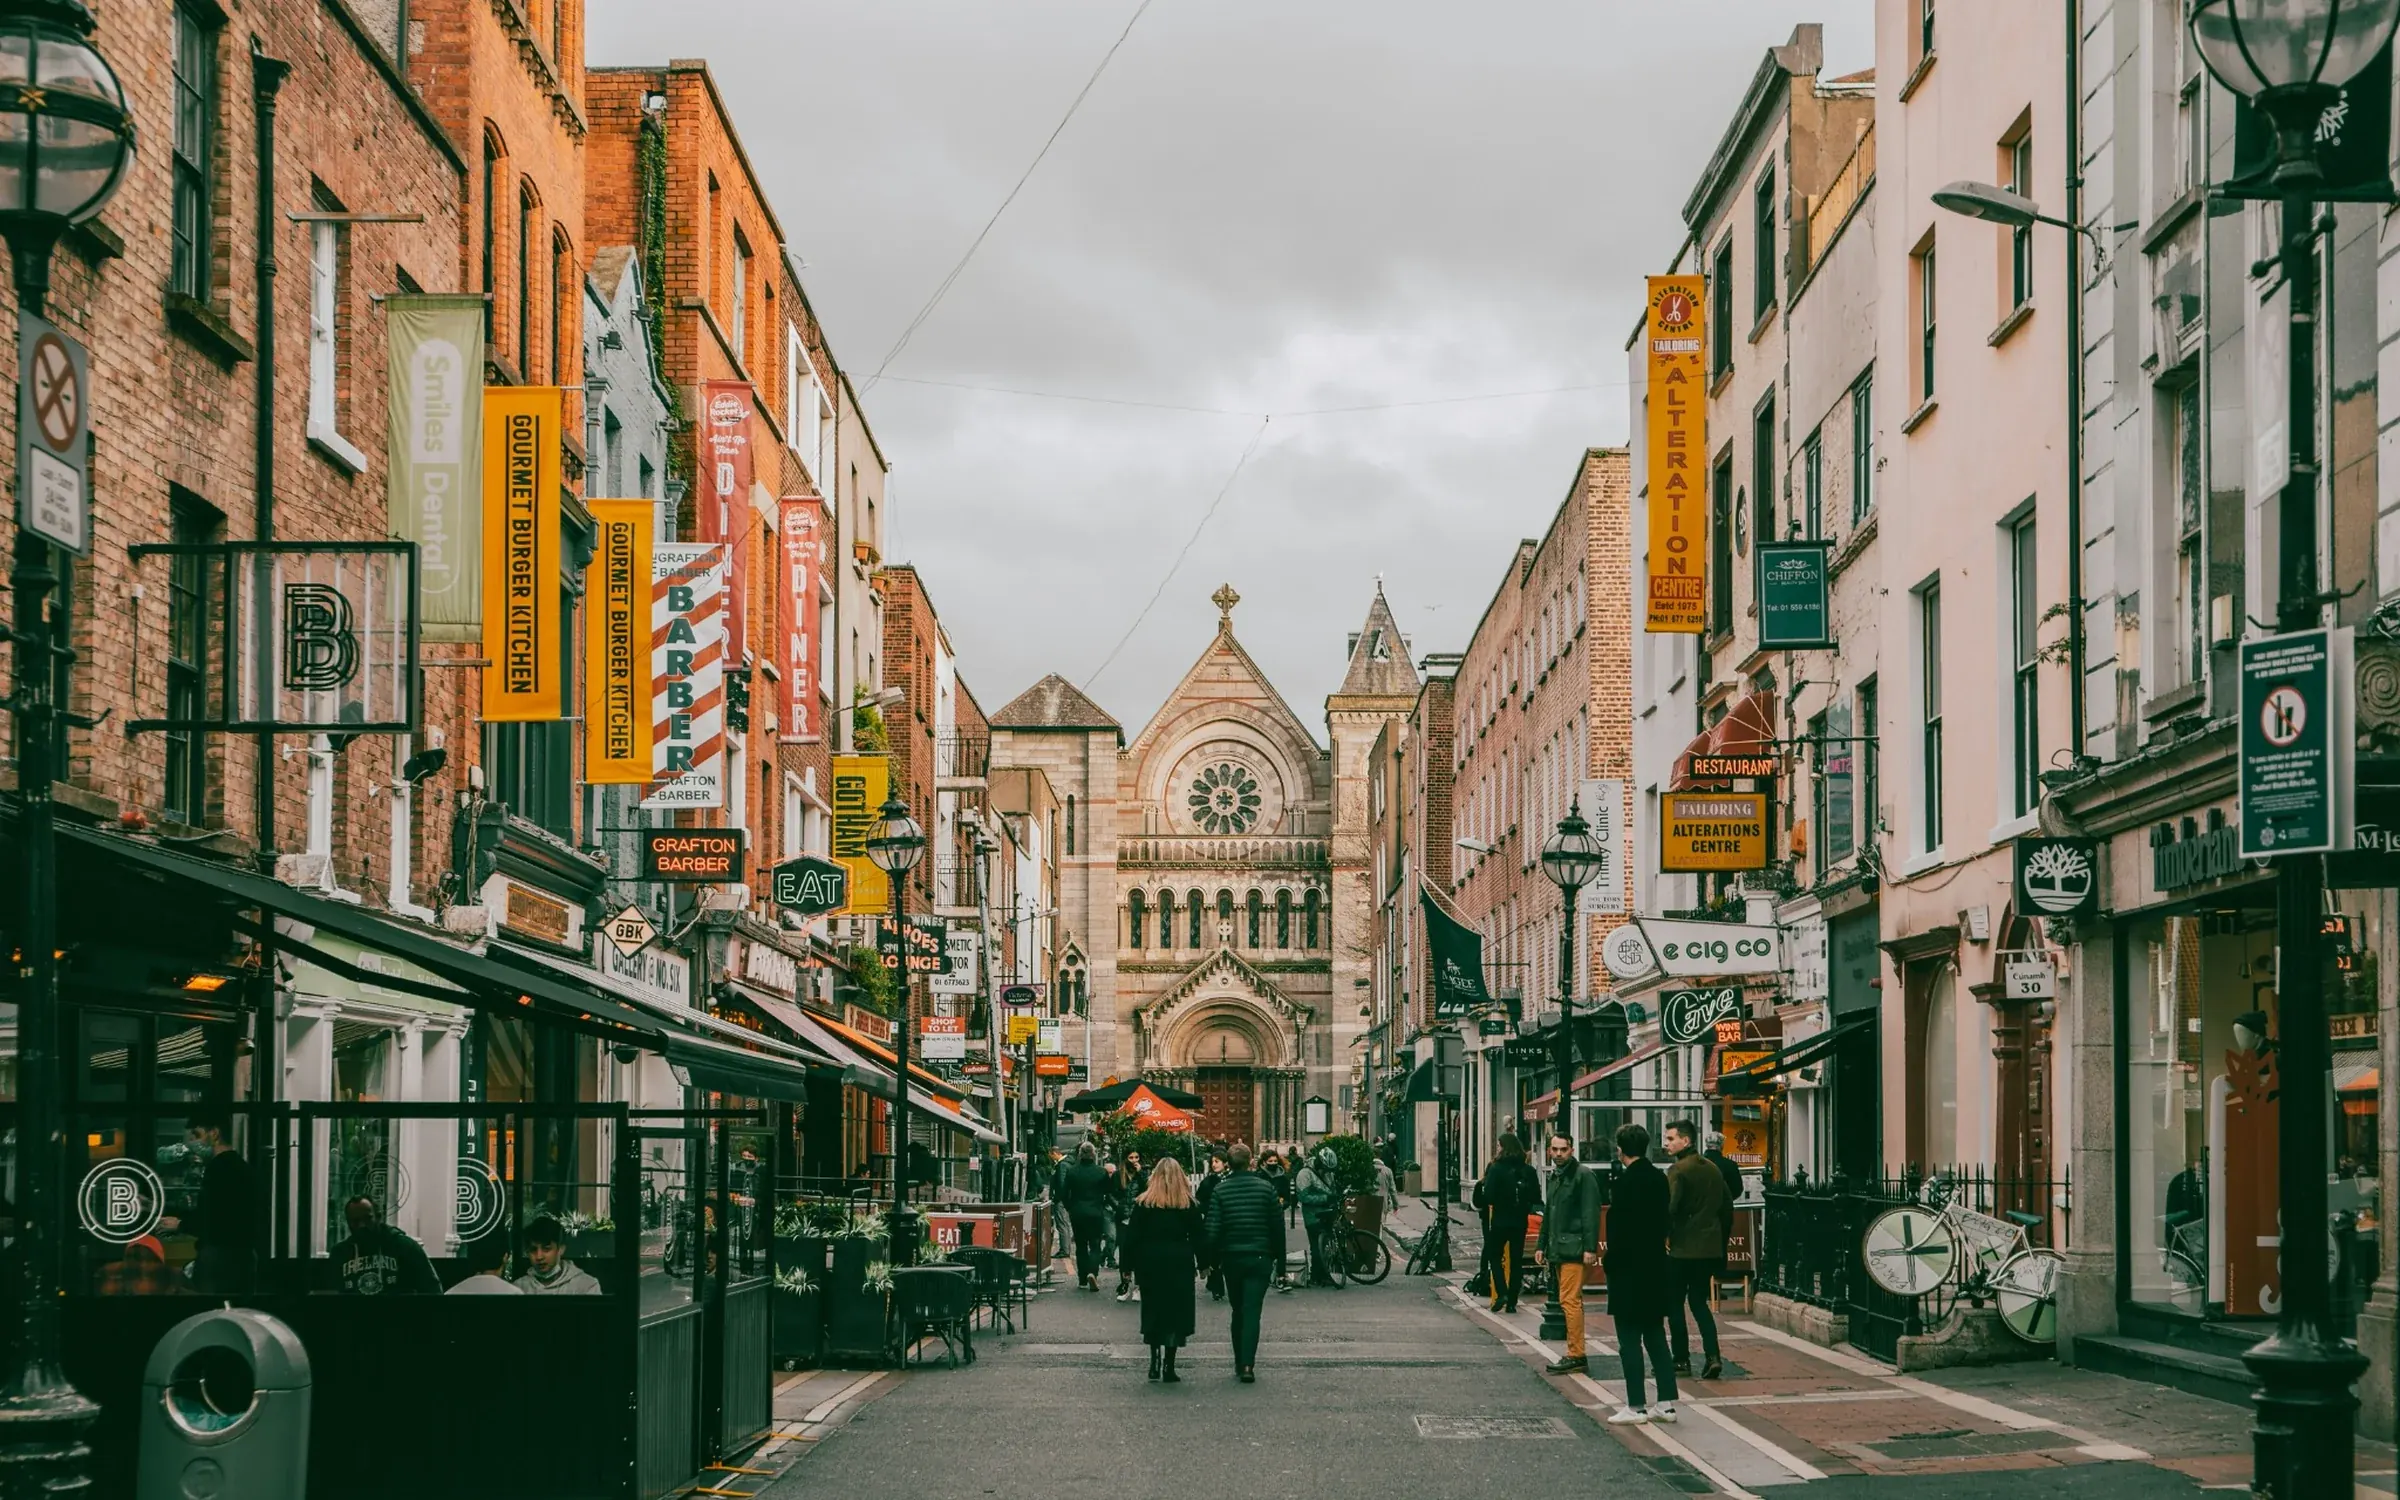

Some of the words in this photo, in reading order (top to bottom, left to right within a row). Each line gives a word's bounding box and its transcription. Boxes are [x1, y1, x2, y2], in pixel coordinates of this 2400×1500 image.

[1652, 286, 1700, 308] ALTERATION
[1657, 320, 1694, 333] CENTRE
[1654, 339, 1700, 352] TAILORING
[423, 355, 452, 453] Smiles
[511, 414, 532, 513] GOURMET
[1665, 367, 1689, 575] ALTERATION
[421, 471, 450, 570] Dental
[511, 518, 532, 598] BURGER
[610, 522, 629, 605] GOURMET
[658, 552, 717, 563] GRAFTON
[660, 567, 711, 577] BARBER
[1766, 570, 1819, 581] CHIFFON
[1653, 578, 1700, 598] CENTRE
[1655, 601, 1675, 610] Estd
[283, 583, 360, 692] B
[610, 610, 629, 678] BURGER
[510, 604, 532, 694] KITCHEN
[790, 564, 808, 735] DINER
[666, 585, 697, 772] BARBER
[610, 684, 629, 760] KITCHEN
[1694, 759, 1774, 776] RESTAURANT
[656, 776, 716, 786] RAFTON
[659, 790, 711, 801] BARBER
[835, 776, 877, 858] GOTHAM
[1680, 803, 1753, 817] TAILORING
[1596, 806, 1610, 842] Clinic
[1672, 823, 1760, 837] ALTERATIONS
[652, 838, 736, 853] GRAFTON
[1691, 840, 1741, 853] CENTRE
[2150, 808, 2246, 893] Timberlan
[658, 857, 730, 872] BARBER
[778, 870, 841, 905] EAT
[615, 923, 645, 940] GBK
[910, 915, 944, 927] WINES
[612, 947, 647, 983] GALLERY
[2020, 982, 2042, 994] 30
[1664, 988, 1741, 1043] Cave
[1718, 1030, 1742, 1042] BAR
[107, 1177, 141, 1226] B
[937, 1227, 961, 1245] EAT
[342, 1254, 398, 1278] IRELAND
